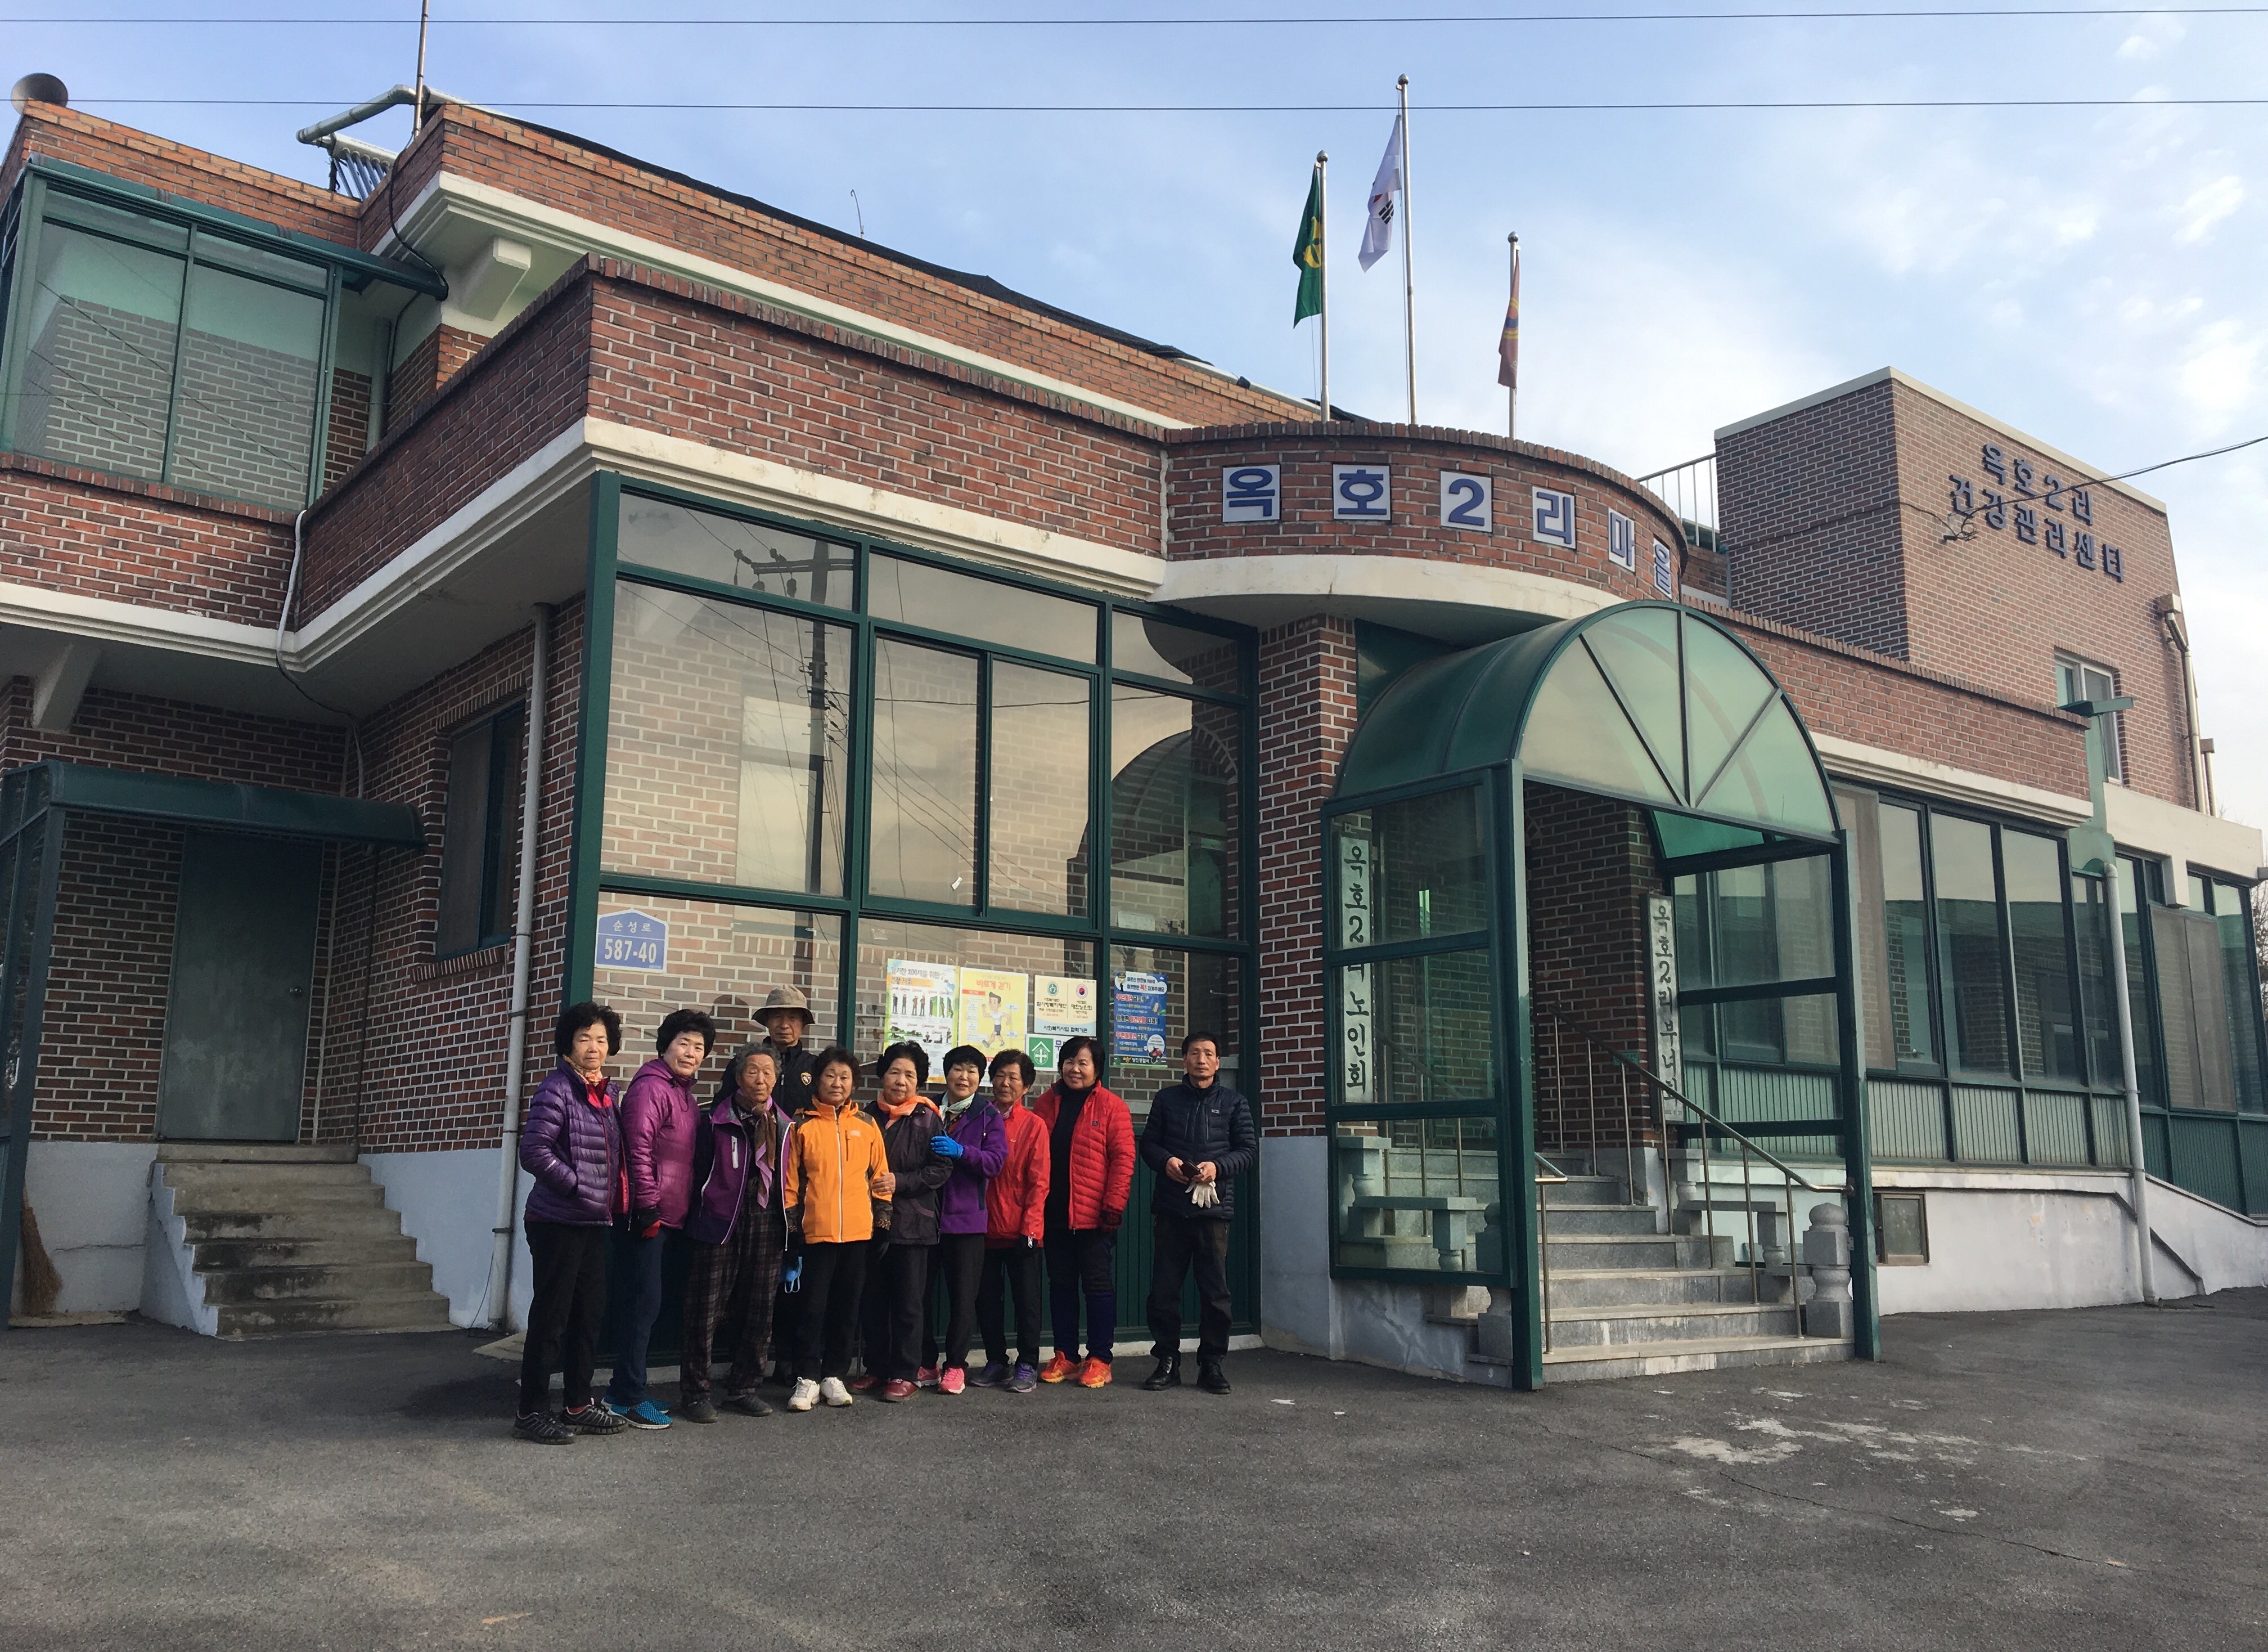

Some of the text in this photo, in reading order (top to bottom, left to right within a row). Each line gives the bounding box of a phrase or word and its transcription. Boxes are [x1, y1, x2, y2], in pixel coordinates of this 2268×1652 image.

[1983, 444, 2094, 526] 옥호2리
[1949, 474, 2125, 582] 건강관리센터
[613, 920, 651, 933] 순성로
[604, 938, 657, 963] 587-40
[976, 980, 1011, 991] 바르게 걷기
